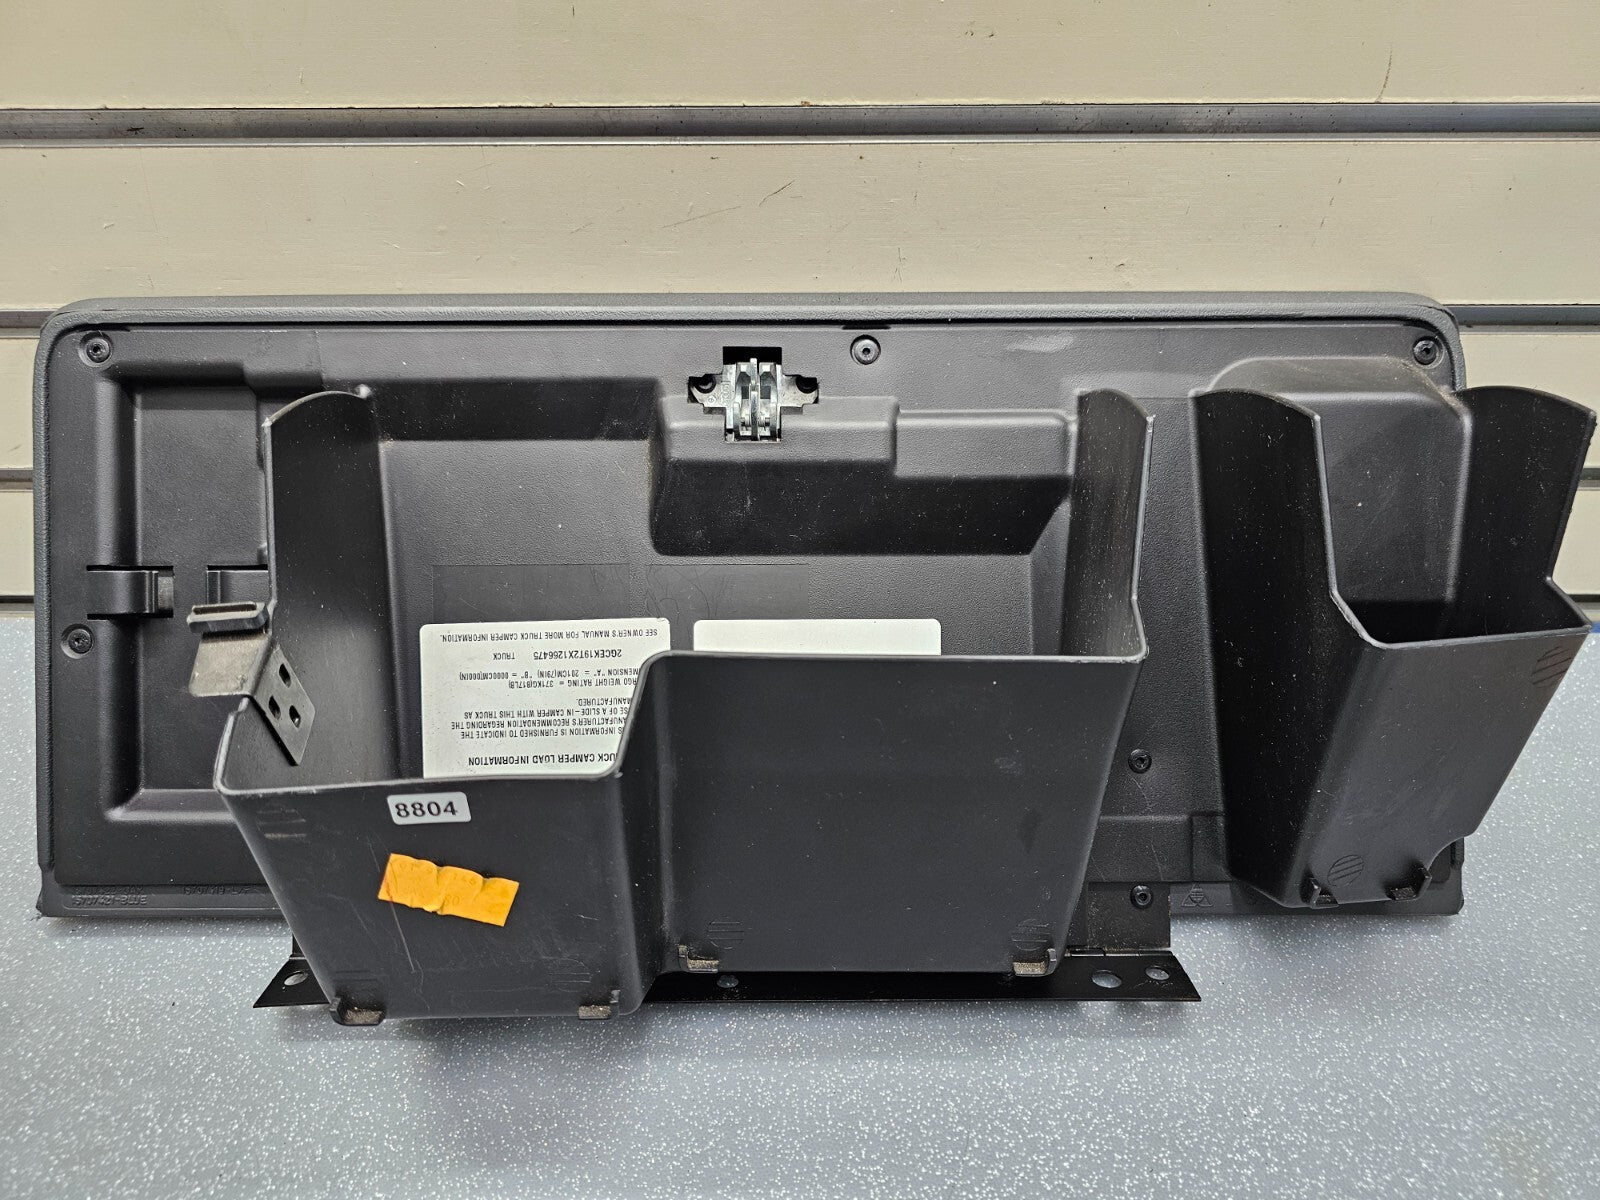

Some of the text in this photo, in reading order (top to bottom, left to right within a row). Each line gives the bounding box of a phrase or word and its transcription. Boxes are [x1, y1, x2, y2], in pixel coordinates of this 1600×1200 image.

[521, 632, 541, 640] TRUCK
[612, 629, 643, 637] OWNER'S
[440, 634, 488, 642] INFORMATION.
[493, 649, 621, 660] 2GCEK19T2X1266475 TRUCK
[608, 668, 639, 676] MENSION
[508, 680, 554, 688] 371KG(817LB)
[595, 678, 620, 686] WEIGHT
[475, 711, 496, 719] TRUCK
[518, 710, 534, 718] WITH
[537, 709, 564, 717] CAMPER
[609, 707, 617, 715] OF
[508, 719, 569, 727] RECOMMENDATION
[520, 729, 558, 737] FURNISHED
[570, 727, 615, 736] INFORMATION
[468, 753, 617, 765] UCK CAMPER LOAD INFORMATION
[395, 801, 458, 818] 8804
